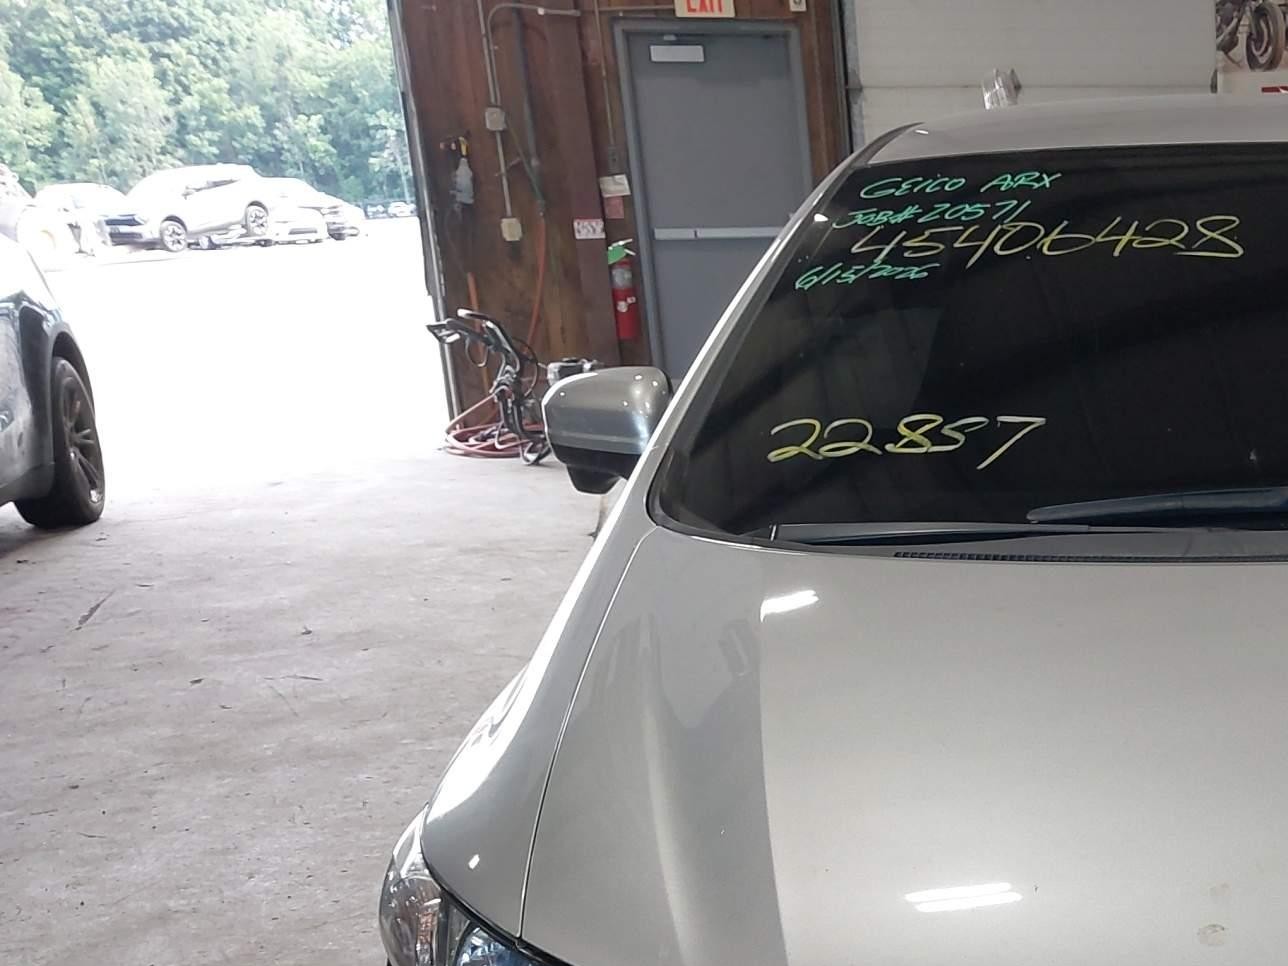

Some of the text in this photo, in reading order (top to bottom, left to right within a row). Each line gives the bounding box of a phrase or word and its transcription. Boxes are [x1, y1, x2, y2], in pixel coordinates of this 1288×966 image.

[860, 171, 1062, 199] GEICO ARX
[850, 215, 1245, 269] 45406428
[767, 413, 1047, 470] 22857
